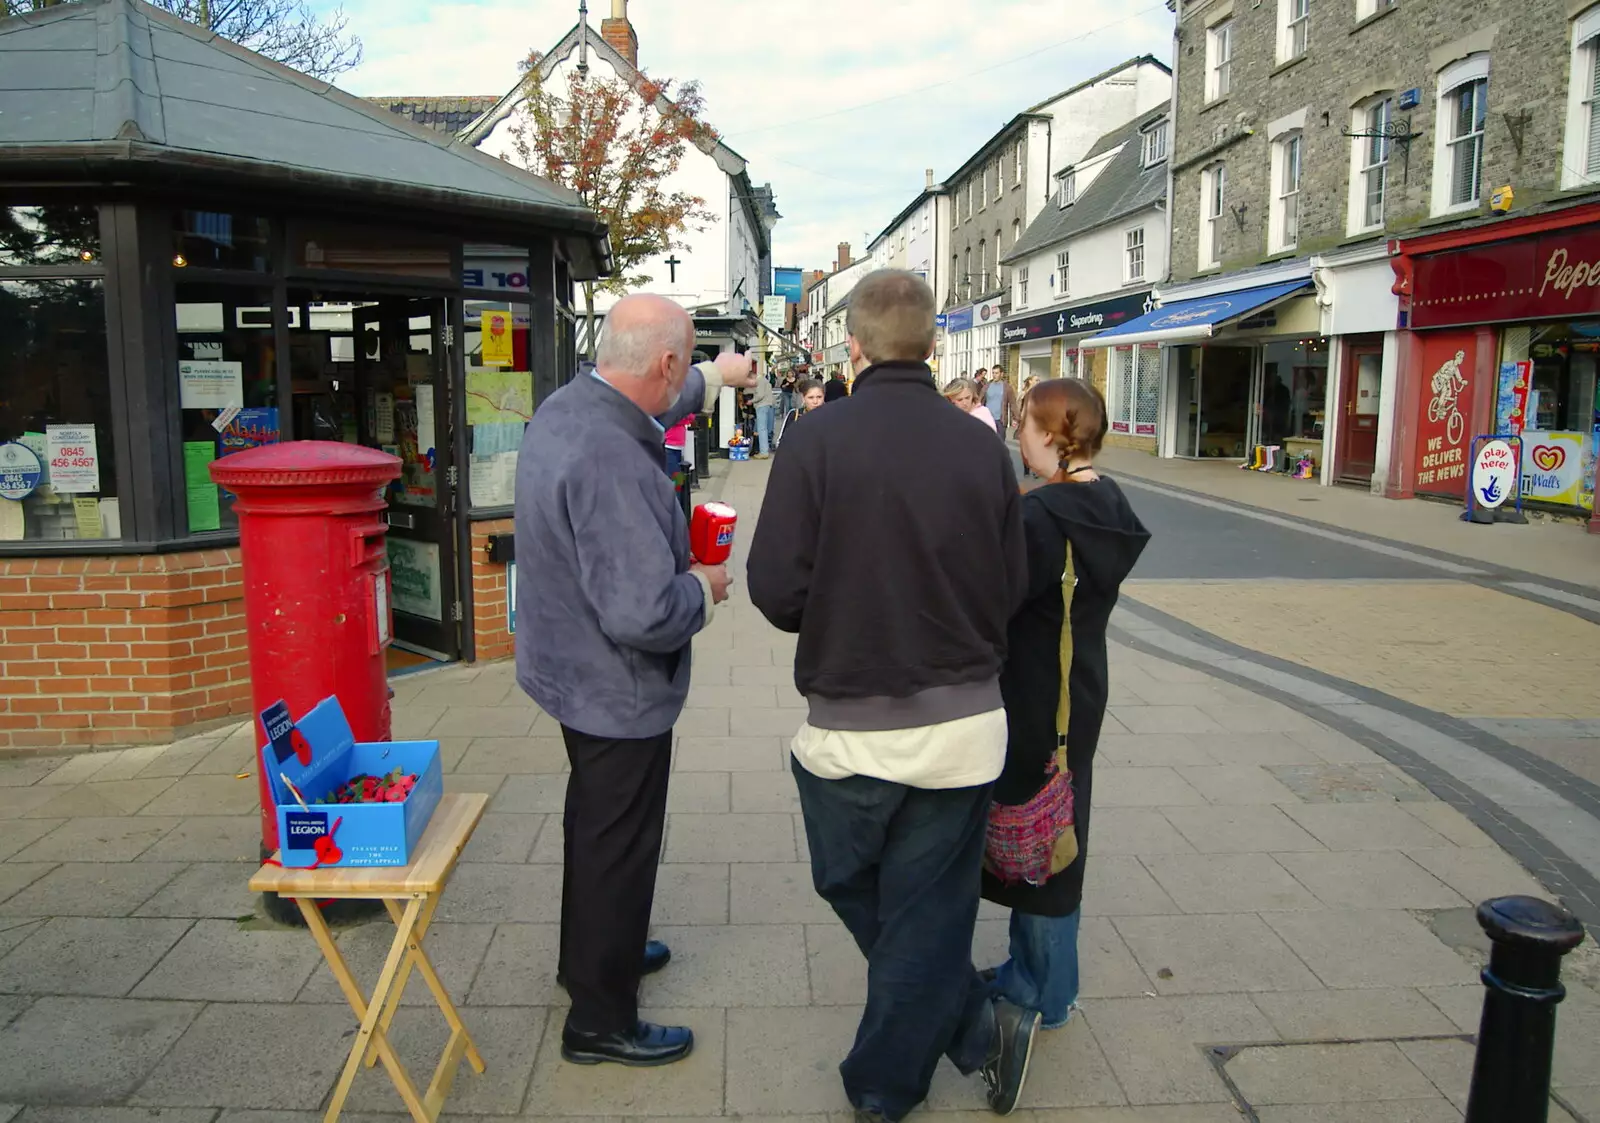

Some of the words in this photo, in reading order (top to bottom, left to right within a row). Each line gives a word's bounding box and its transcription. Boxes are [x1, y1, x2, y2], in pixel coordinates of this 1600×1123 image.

[1070, 312, 1104, 329] Superdrug
[1004, 326, 1027, 340] Superdrug
[223, 418, 281, 442] Aladdin
[1428, 436, 1443, 450] WE
[60, 447, 85, 457] 0845
[1423, 449, 1462, 467] DELIVER
[1483, 448, 1508, 460] play
[51, 458, 70, 467] 456
[71, 457, 95, 467] 4567
[1480, 459, 1509, 470] here!
[4, 474, 23, 482] 0845
[1418, 469, 1436, 485] THE
[1437, 463, 1465, 481] NEWS
[1533, 474, 1560, 489] Wall's
[269, 718, 294, 741] LEGION
[290, 825, 326, 835] LEGION
